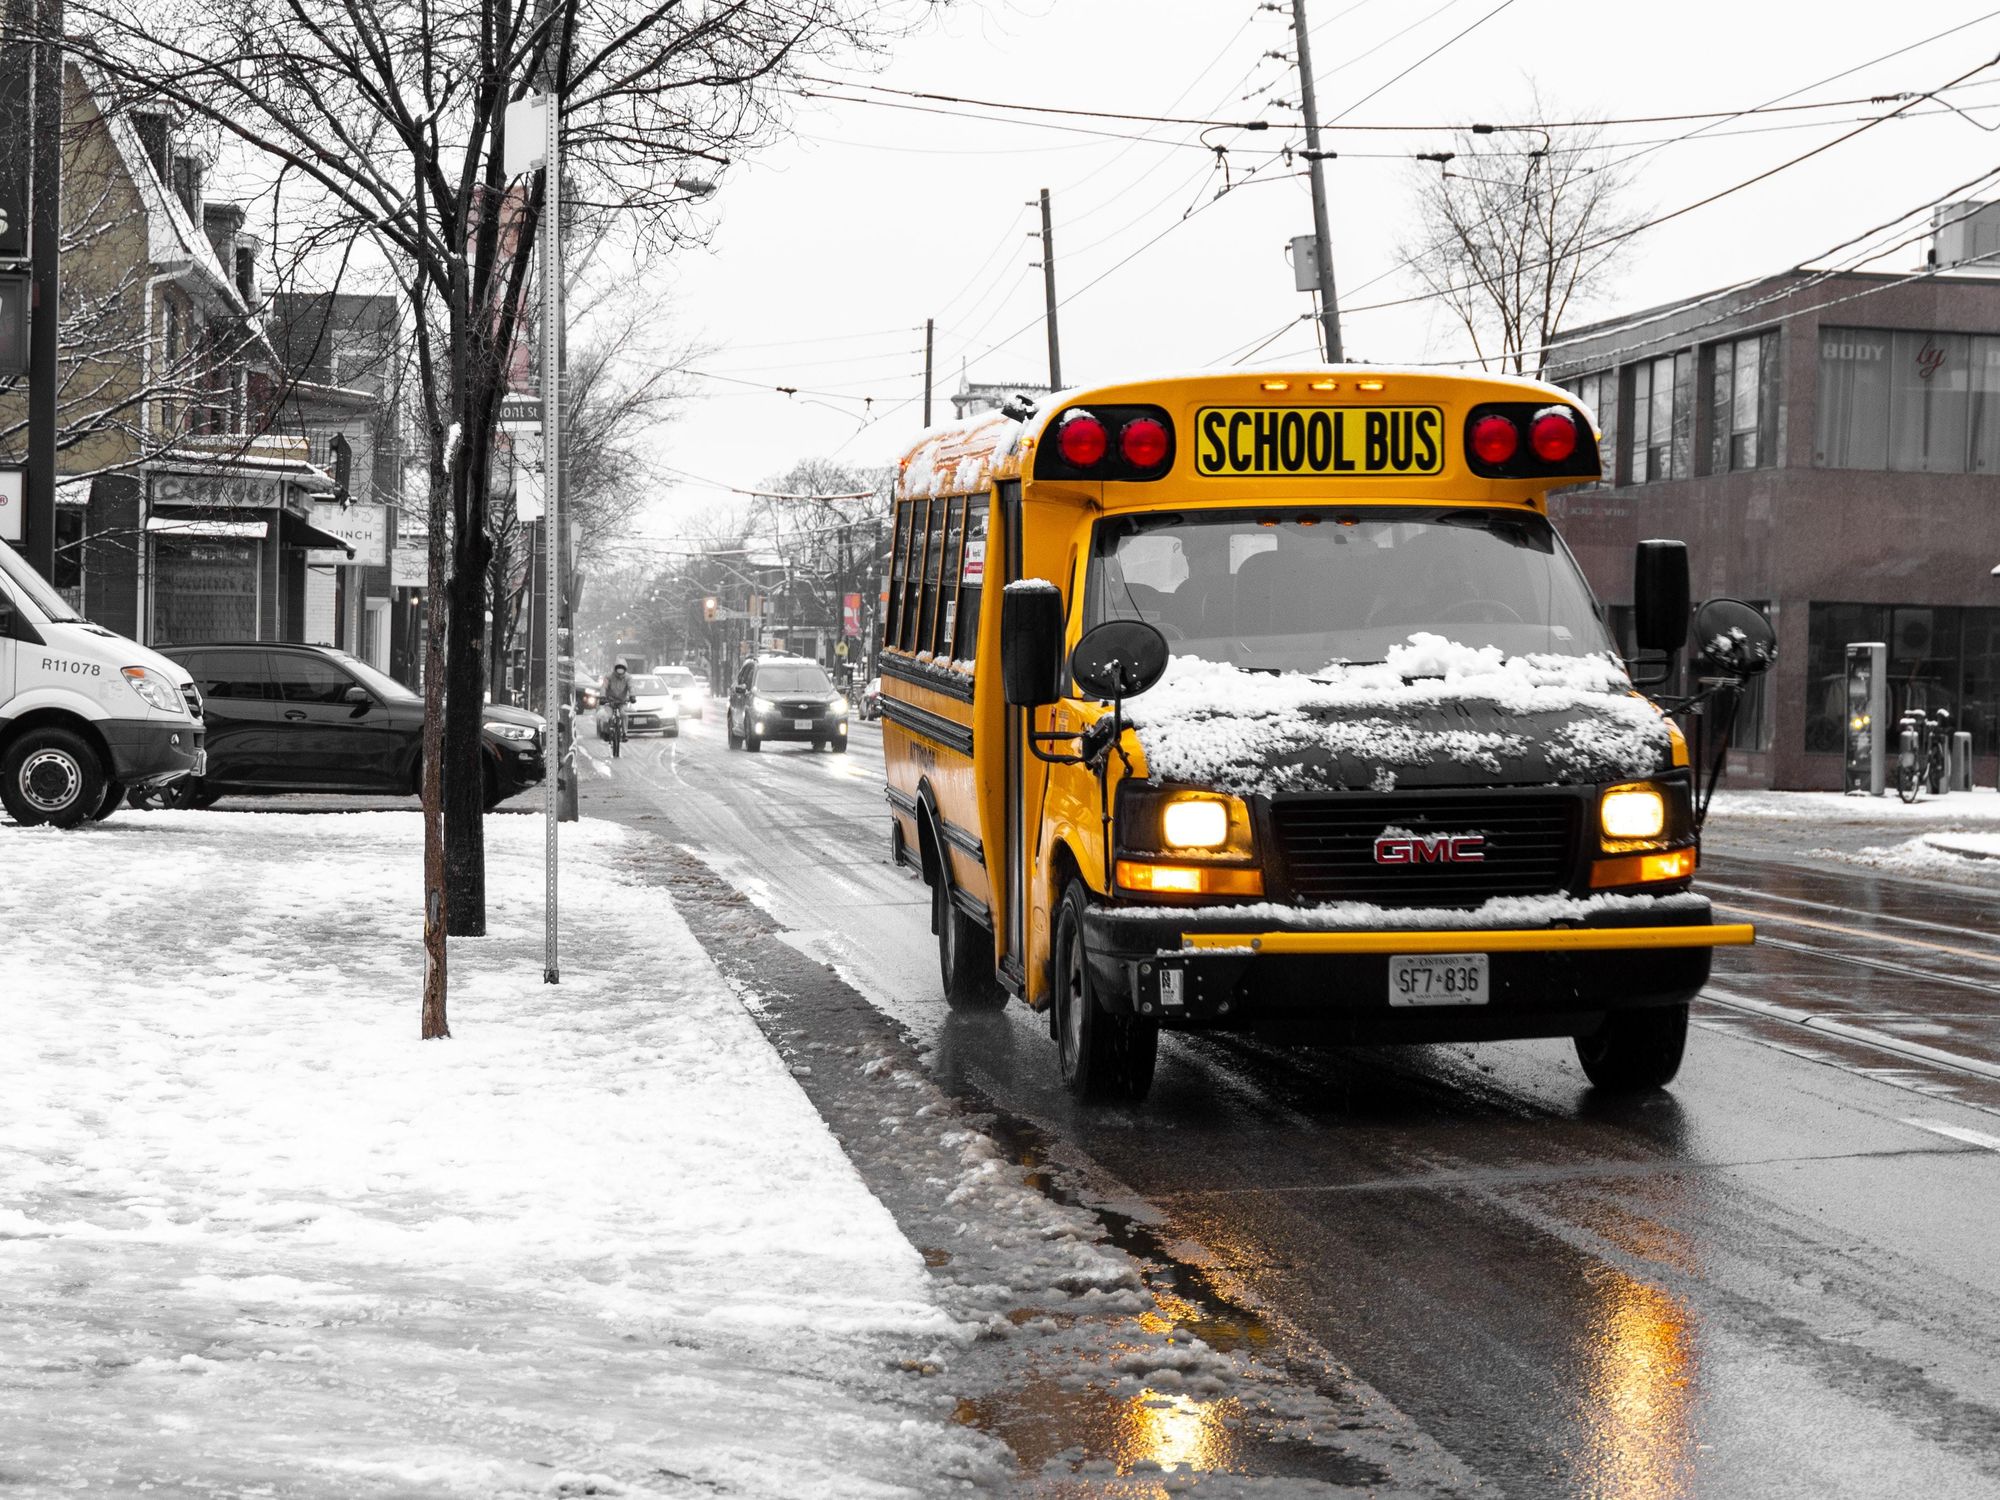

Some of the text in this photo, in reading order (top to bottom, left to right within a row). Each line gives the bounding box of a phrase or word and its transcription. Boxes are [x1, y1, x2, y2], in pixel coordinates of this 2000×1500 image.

[1822, 342, 1885, 361] BODY
[1916, 334, 1947, 379] by
[1203, 410, 1438, 472] SCHOOL BUS
[327, 529, 372, 541] UNCH
[42, 658, 101, 677] R11078
[1374, 835, 1485, 864] GMC
